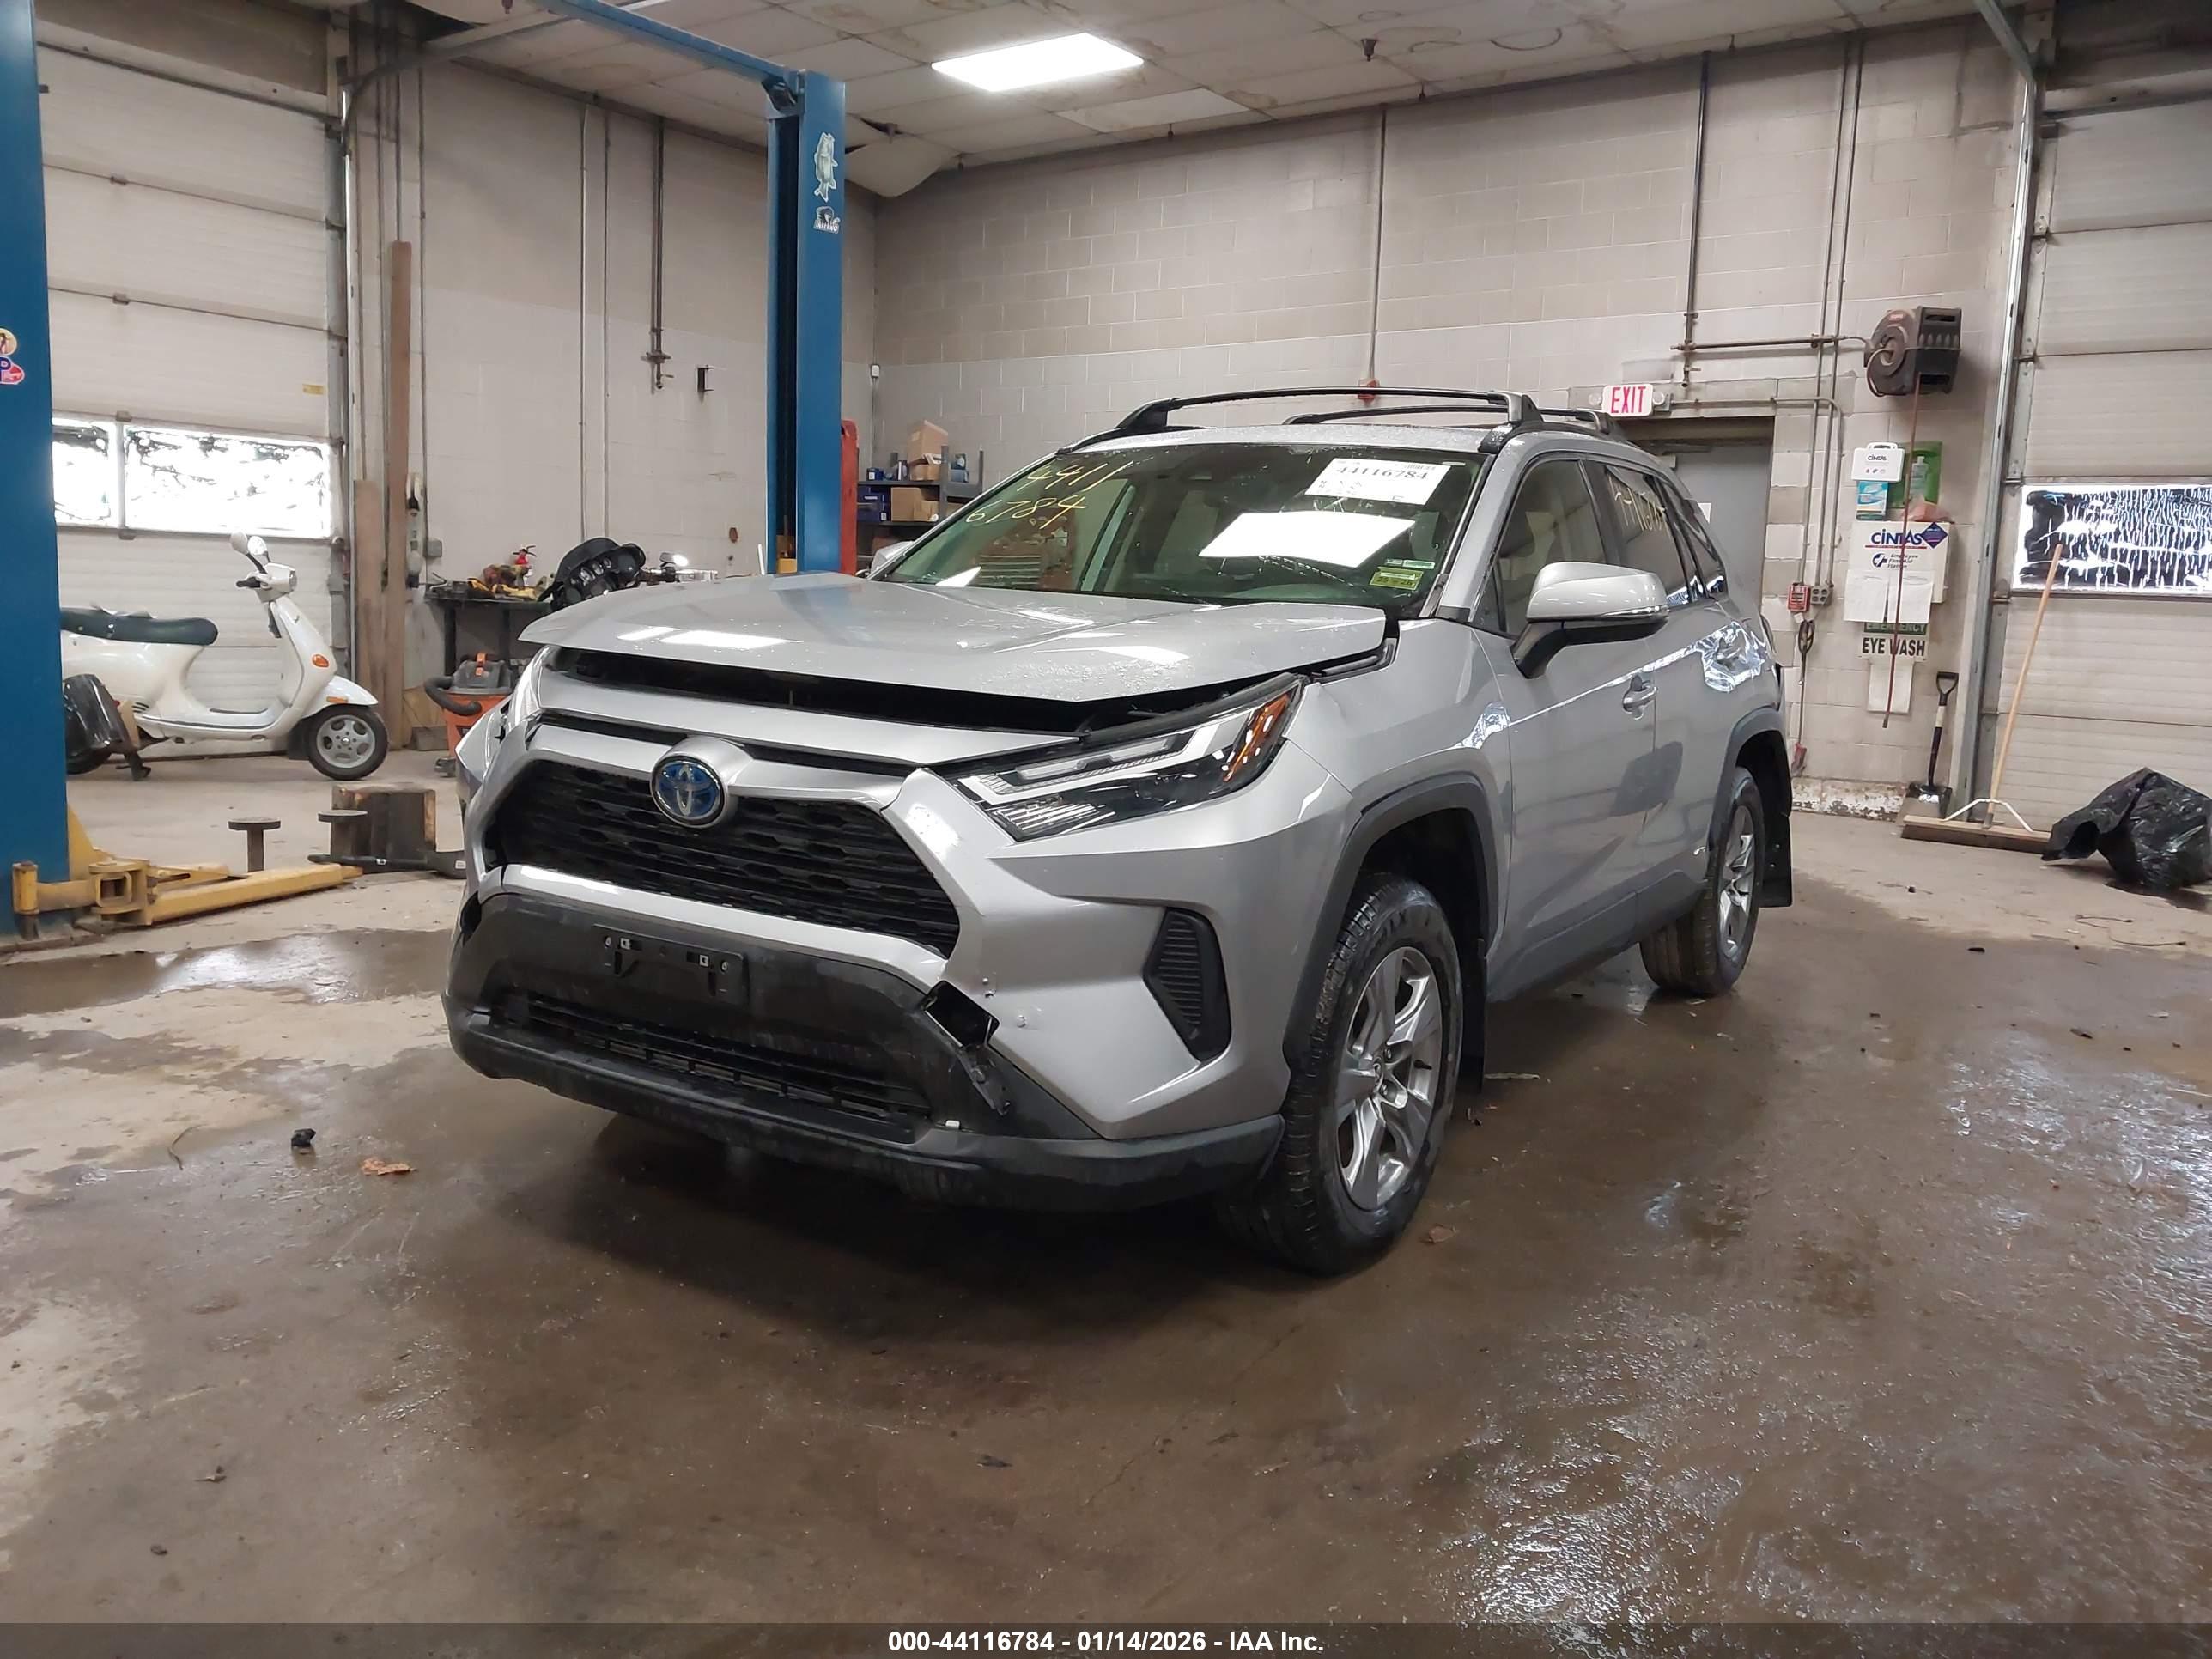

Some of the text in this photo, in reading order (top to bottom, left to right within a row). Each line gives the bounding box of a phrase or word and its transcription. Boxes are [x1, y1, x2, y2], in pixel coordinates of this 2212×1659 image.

[1611, 386, 1646, 413] EXIT
[1336, 466, 1429, 479] 44116784
[966, 495, 1088, 529] 6784
[1863, 637, 1925, 656] EYE WASH
